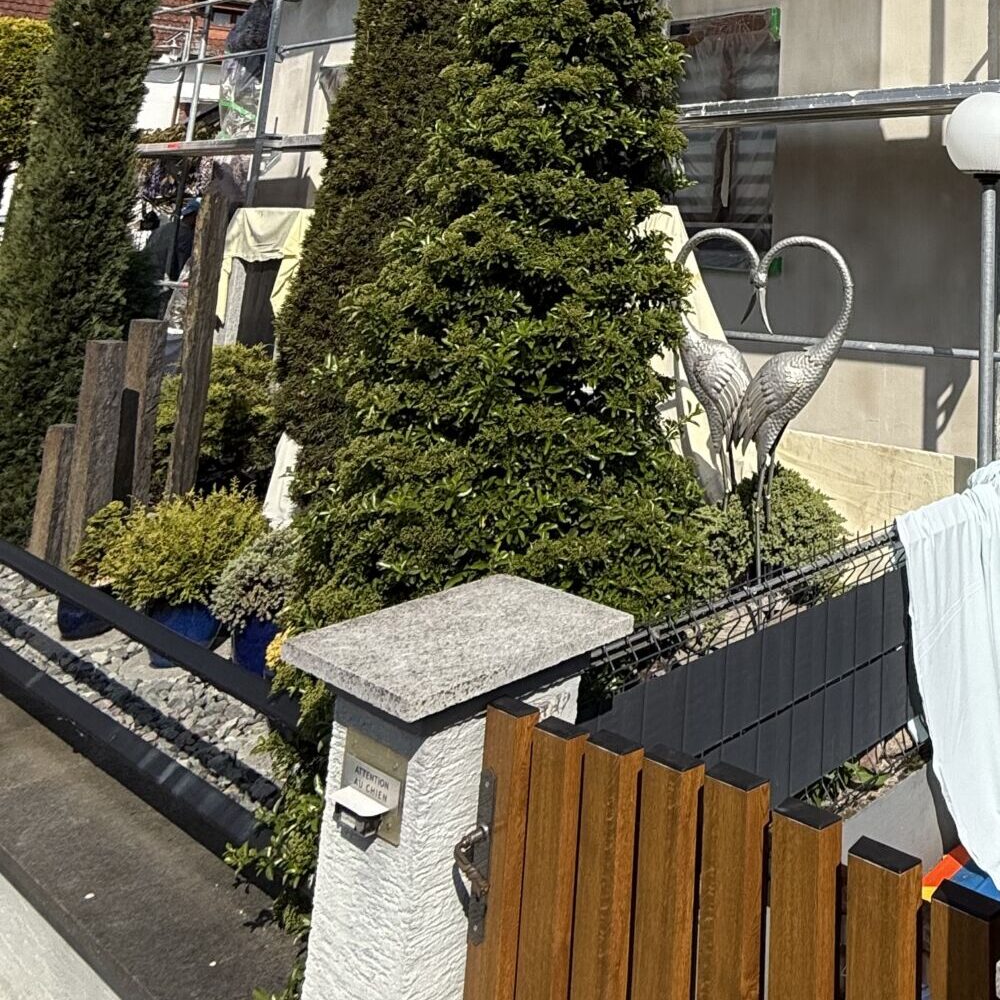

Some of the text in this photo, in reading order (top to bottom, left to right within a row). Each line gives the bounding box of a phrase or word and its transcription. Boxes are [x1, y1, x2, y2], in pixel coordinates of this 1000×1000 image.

[353, 777, 388, 802] AU CHIEN
[354, 765, 390, 790] ATTENTION
